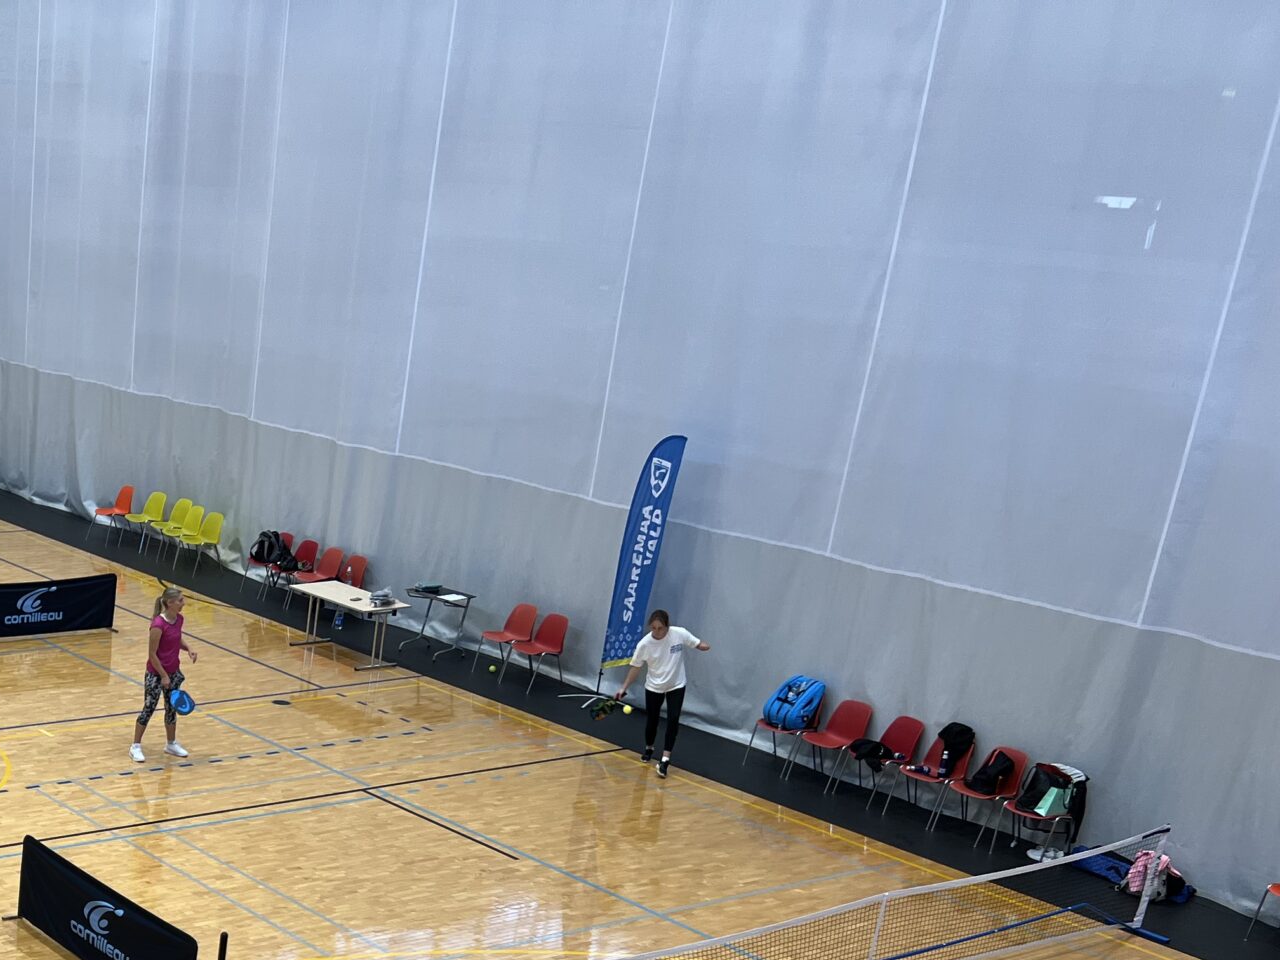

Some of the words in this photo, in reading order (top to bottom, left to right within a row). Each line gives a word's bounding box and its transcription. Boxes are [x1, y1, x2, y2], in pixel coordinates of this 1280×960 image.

[623, 504, 653, 624] SAAREMAA
[643, 508, 662, 566] VALD
[4, 611, 63, 625] cornilleau
